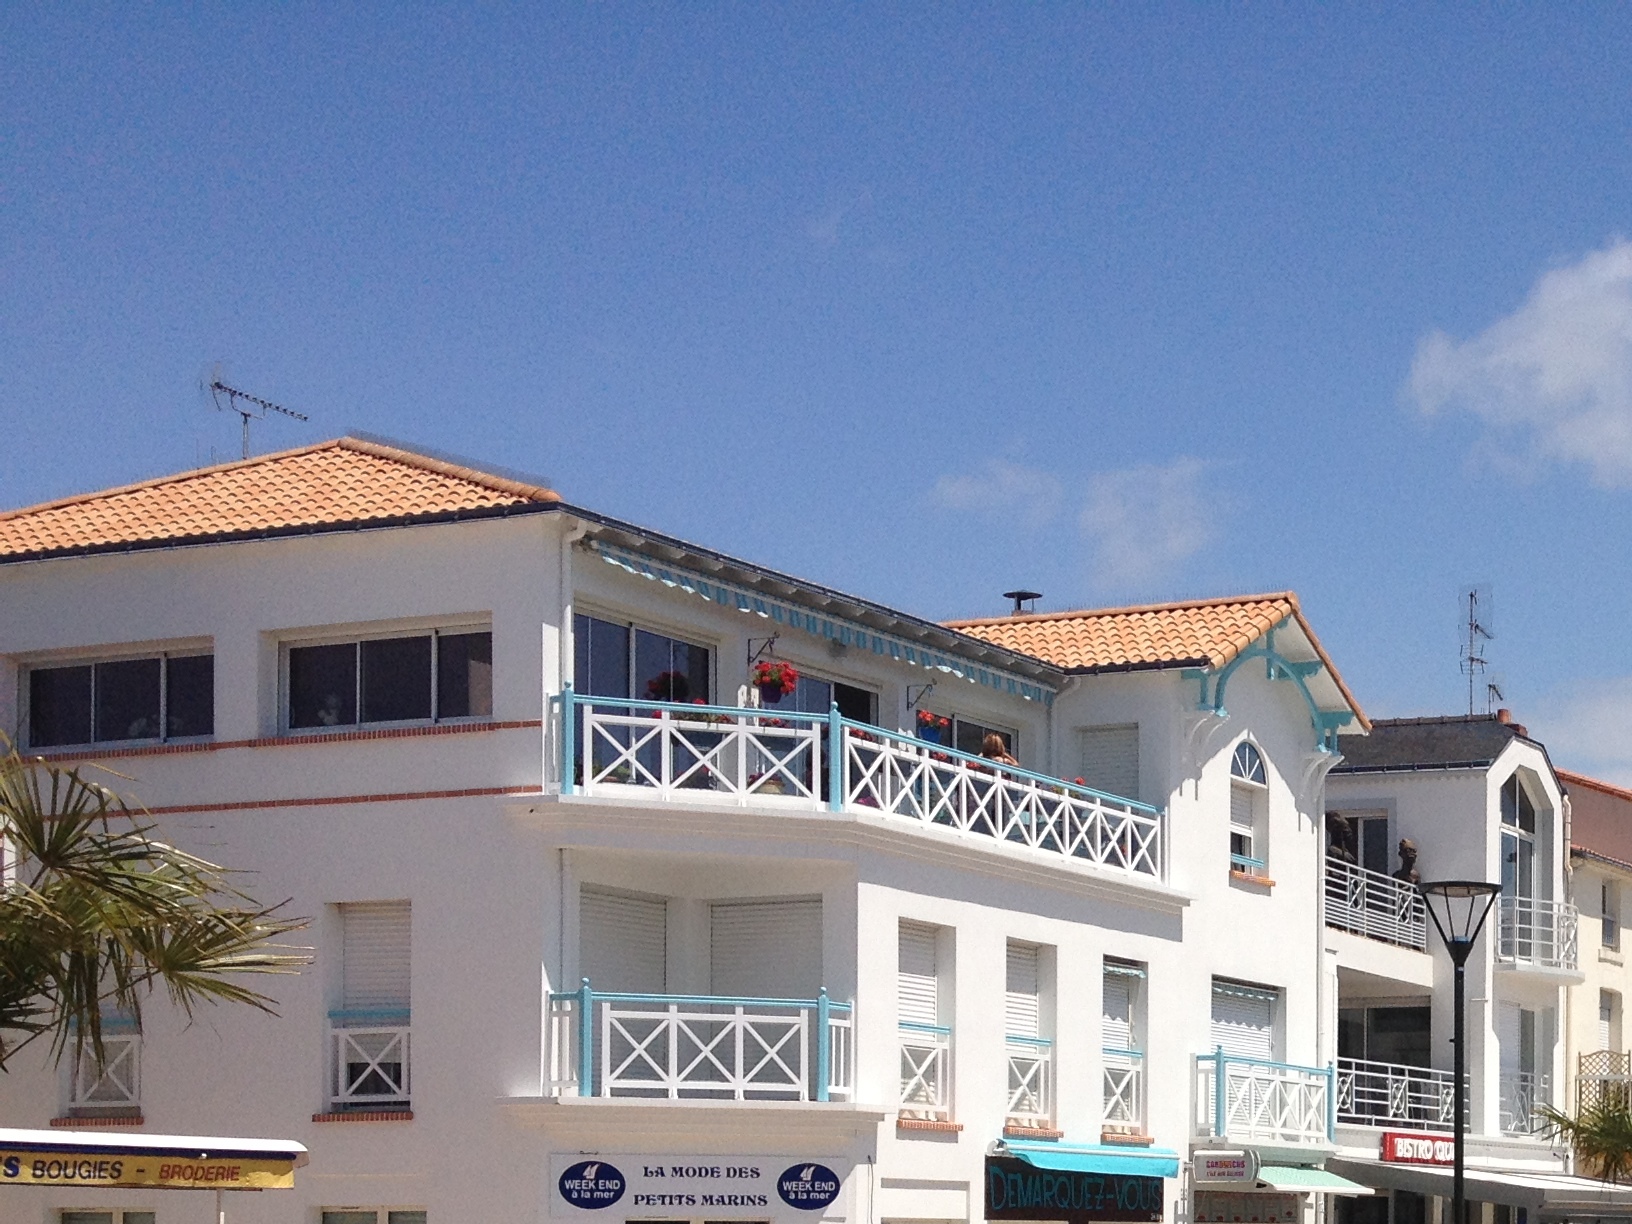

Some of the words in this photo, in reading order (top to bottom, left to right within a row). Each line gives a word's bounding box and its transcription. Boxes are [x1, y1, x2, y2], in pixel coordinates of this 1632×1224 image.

[1394, 1137, 1433, 1160] BISTRO
[0, 1155, 20, 1178] S
[32, 1160, 124, 1181] BOUGIES
[158, 1163, 242, 1182] BRODERIE
[642, 1165, 666, 1178] LA
[671, 1166, 722, 1179] MODE
[726, 1166, 761, 1179] DES
[564, 1179, 597, 1190] WEEK
[598, 1179, 621, 1190] END
[782, 1181, 813, 1192] WEEK
[815, 1181, 836, 1192] END
[571, 1189, 579, 1199] à
[580, 1190, 591, 1199] la
[594, 1190, 615, 1200] mer
[788, 1190, 796, 1200] à
[798, 1191, 807, 1200] la
[810, 1191, 831, 1201] mer
[633, 1194, 697, 1207] PETITS
[700, 1194, 768, 1208] MARINS
